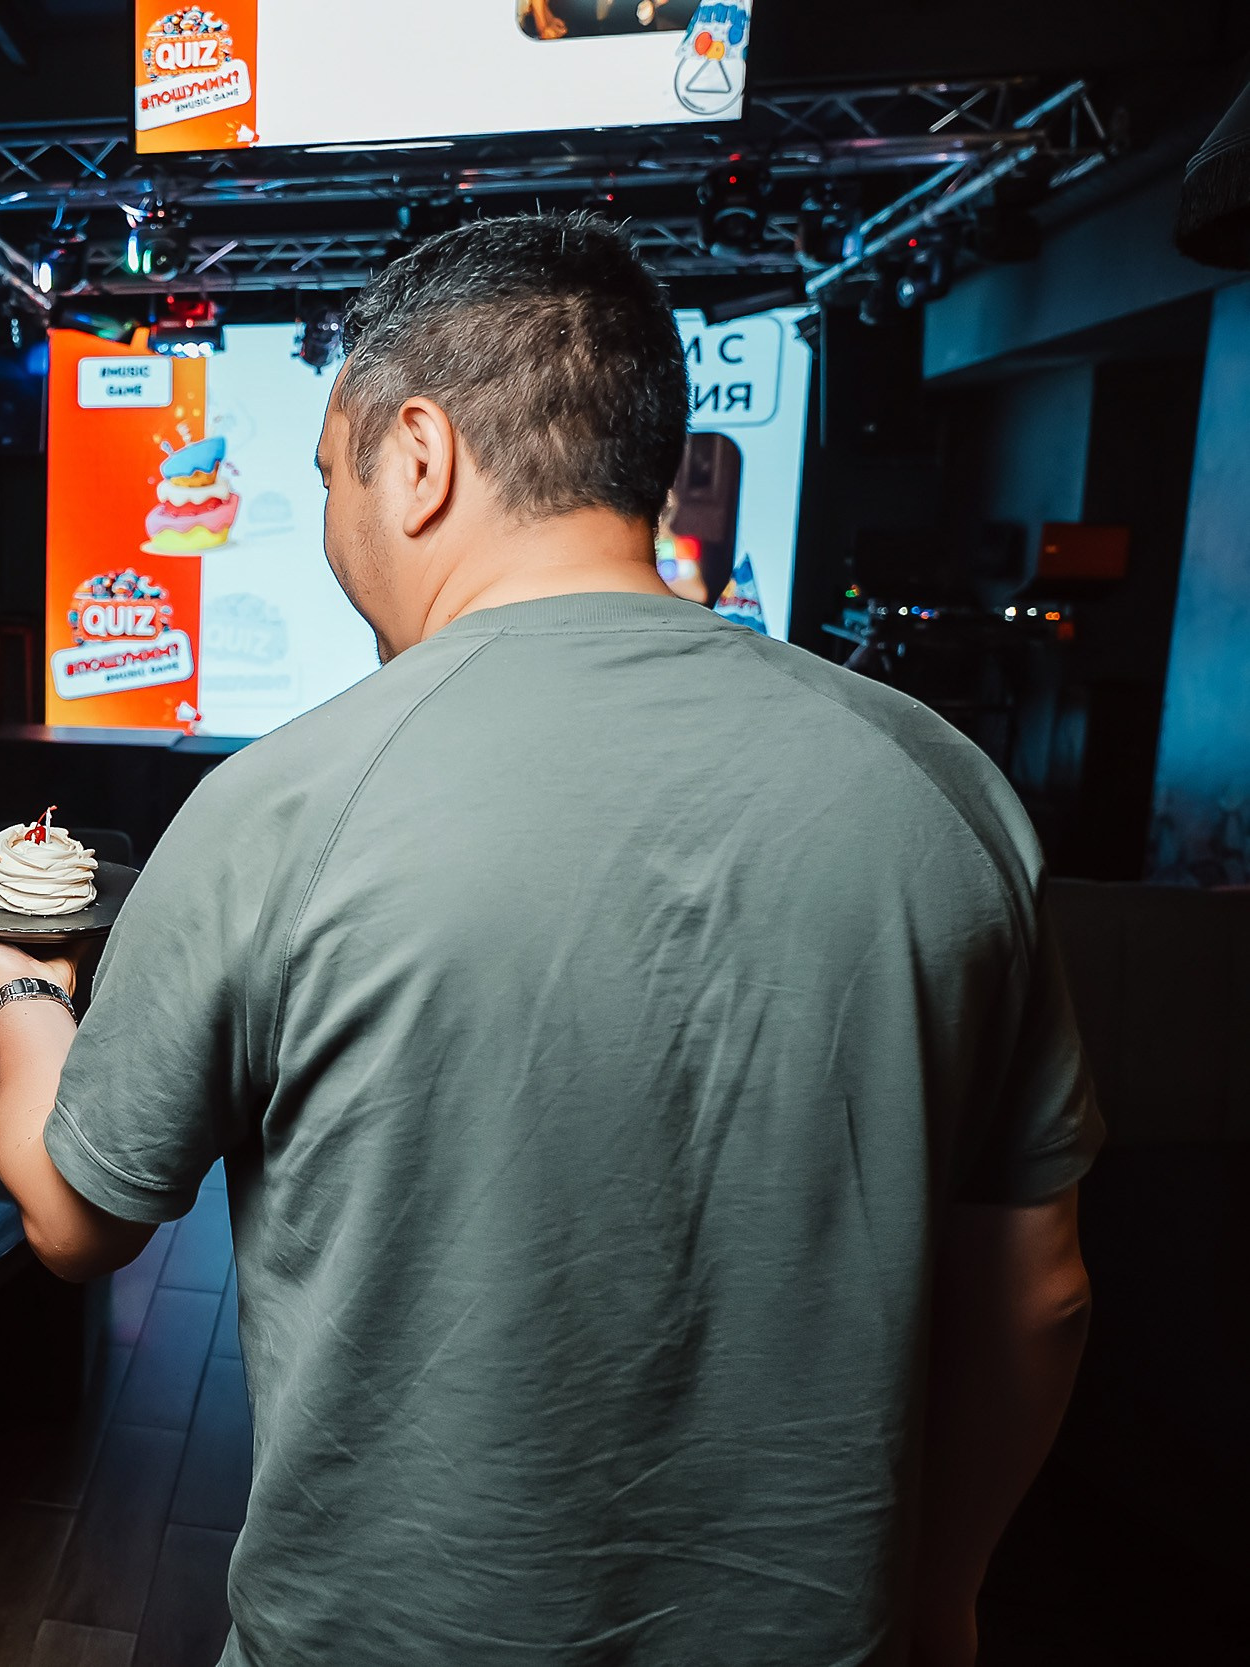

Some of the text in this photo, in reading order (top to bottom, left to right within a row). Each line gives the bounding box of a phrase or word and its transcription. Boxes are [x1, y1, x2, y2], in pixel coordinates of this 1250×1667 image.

[155, 40, 218, 71] QUIZ
[213, 88, 239, 102] GAME
[718, 333, 745, 364] С
[82, 605, 157, 637] QUIZ
